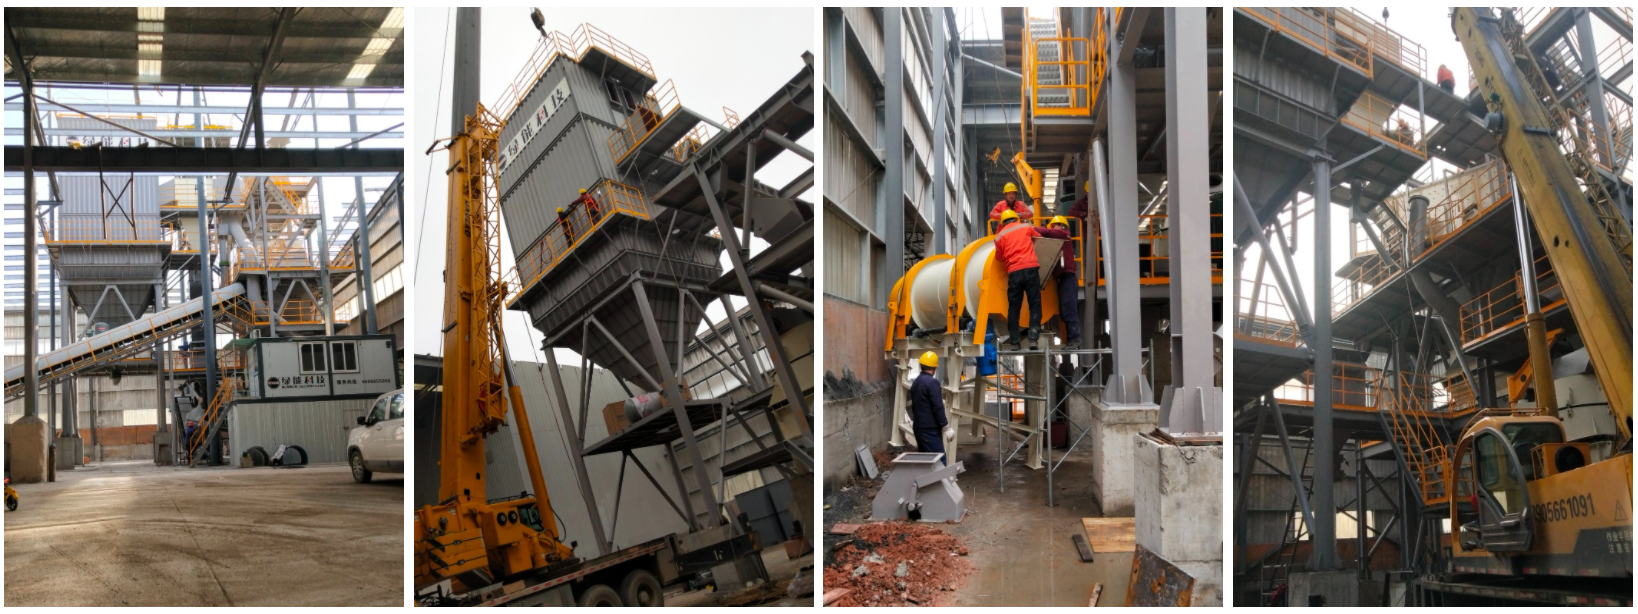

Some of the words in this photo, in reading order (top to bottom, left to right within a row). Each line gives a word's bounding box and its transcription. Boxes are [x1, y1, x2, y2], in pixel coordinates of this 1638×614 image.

[507, 89, 564, 156] 绿能科技
[281, 375, 325, 385] 绿能科技
